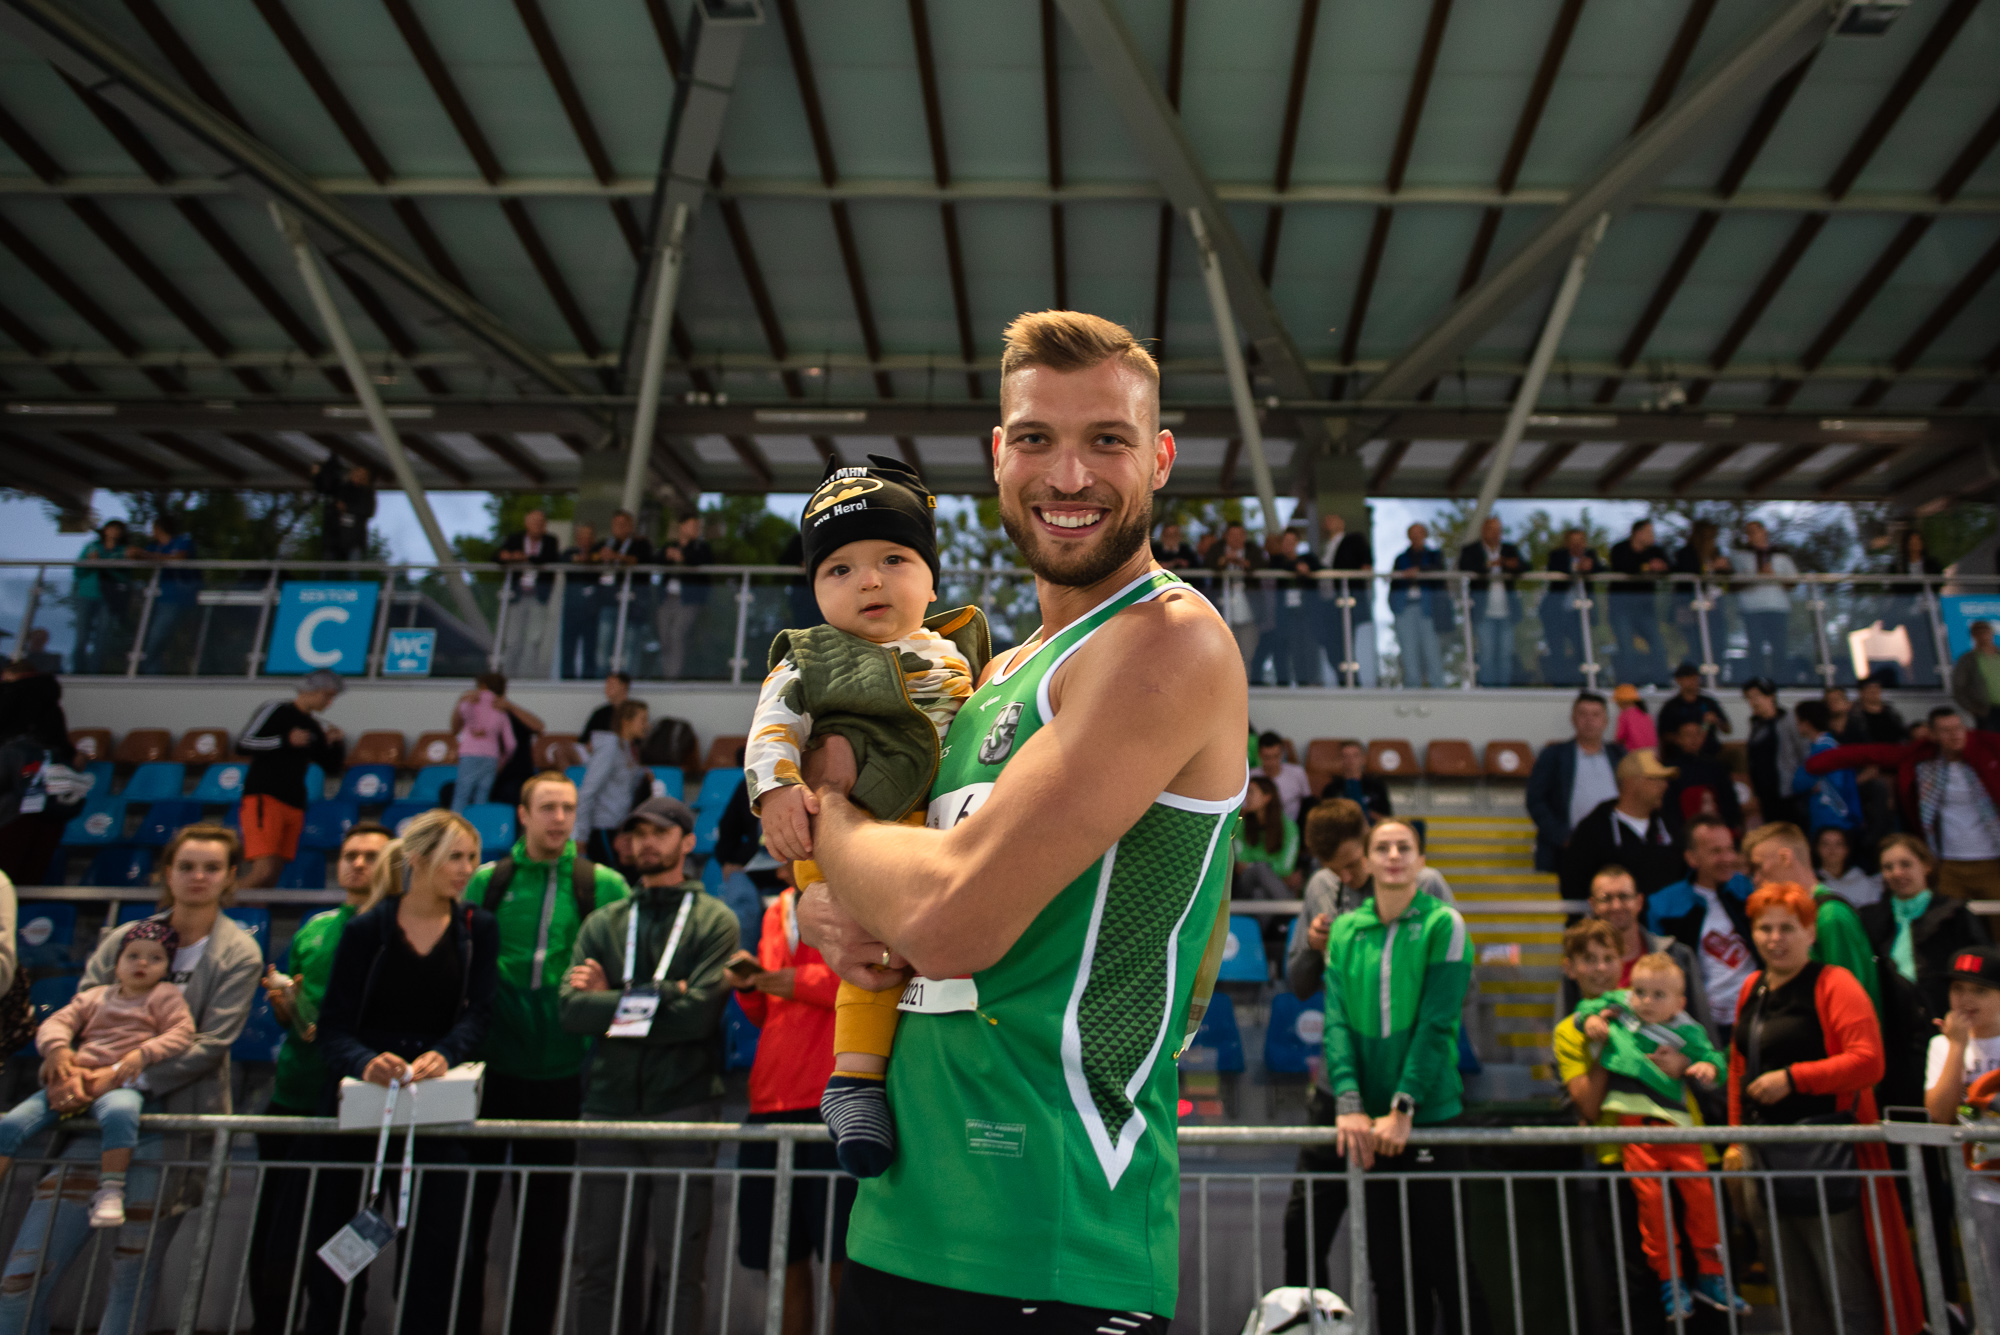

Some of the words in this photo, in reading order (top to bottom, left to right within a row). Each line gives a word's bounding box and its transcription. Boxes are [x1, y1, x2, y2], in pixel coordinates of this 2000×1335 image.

[833, 499, 867, 516] Hero!
[295, 605, 350, 668] C
[391, 636, 431, 658] WC
